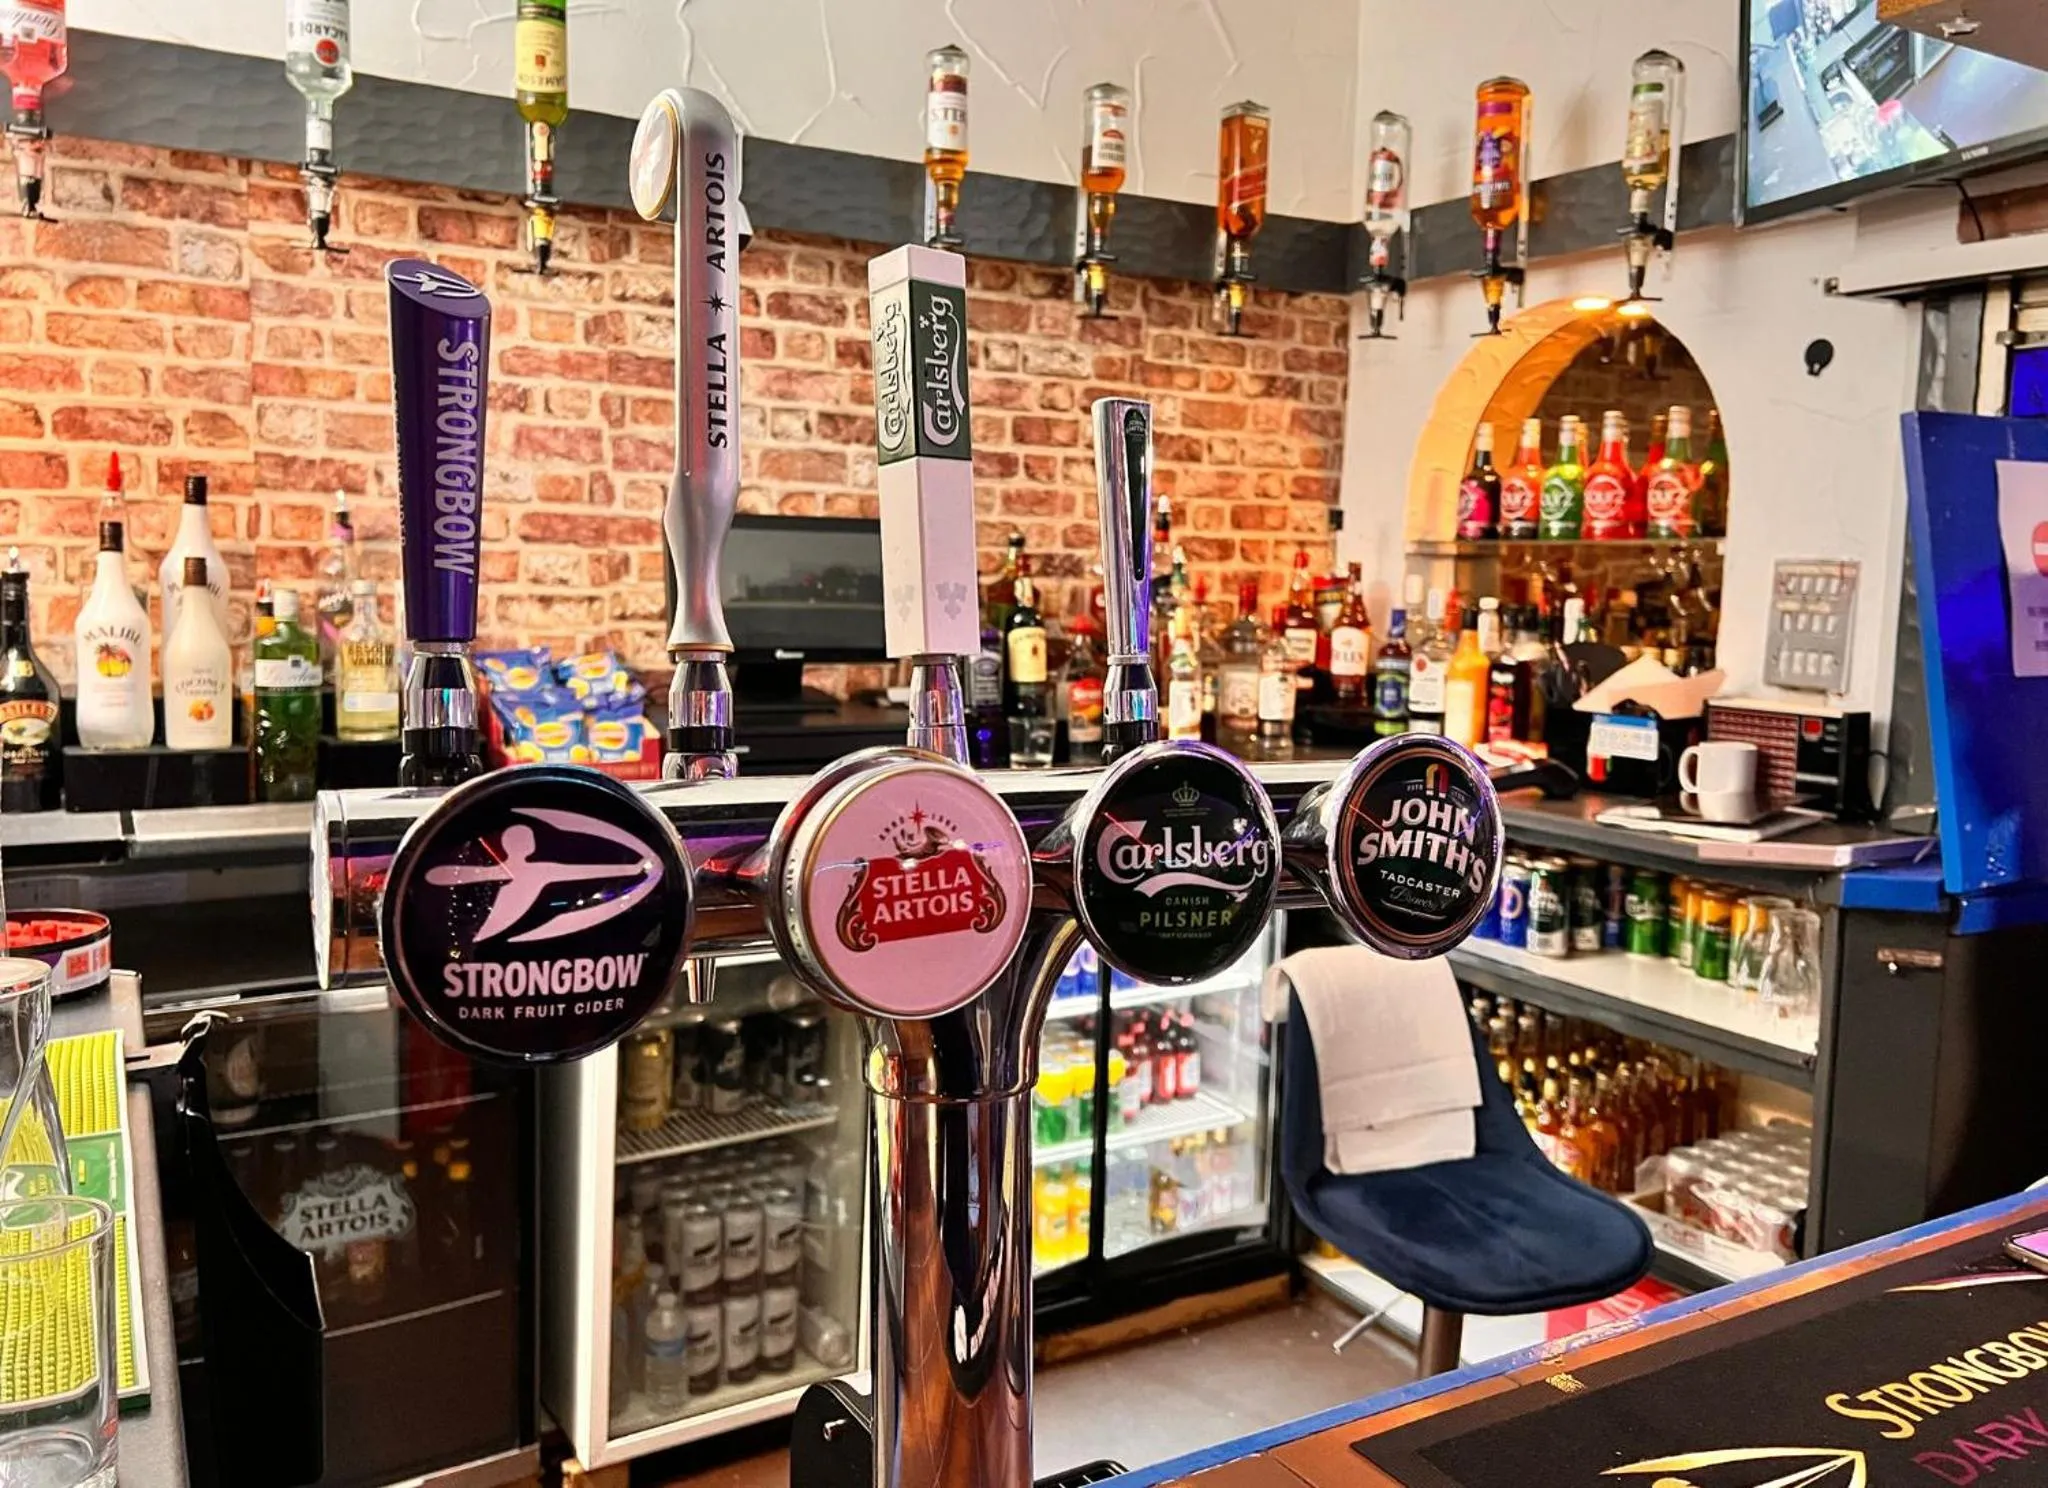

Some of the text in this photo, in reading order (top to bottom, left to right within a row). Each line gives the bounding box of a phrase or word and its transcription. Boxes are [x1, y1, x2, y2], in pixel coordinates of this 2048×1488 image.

[705, 150, 728, 449] STELLA ARTOIS
[876, 300, 908, 452] Carlsberg
[922, 294, 961, 446] Carlsberg
[433, 337, 480, 576] STRONGBOW
[84, 626, 142, 644] MALIBU
[1382, 797, 1475, 845] JOHN
[1096, 820, 1269, 885] Carlsberg
[1356, 829, 1487, 894] SMITH'S
[872, 866, 972, 899] STELLA
[1380, 869, 1460, 899] TADCASTER
[873, 891, 974, 925] ARTOIS
[1165, 896, 1210, 906] DANISH
[1140, 909, 1234, 928] PILSNER
[443, 953, 644, 998] STRONGBOW
[458, 997, 625, 1020] DARK FRUIT CIDER
[301, 1192, 389, 1222] STELLA
[300, 1211, 390, 1242] ARTOIS
